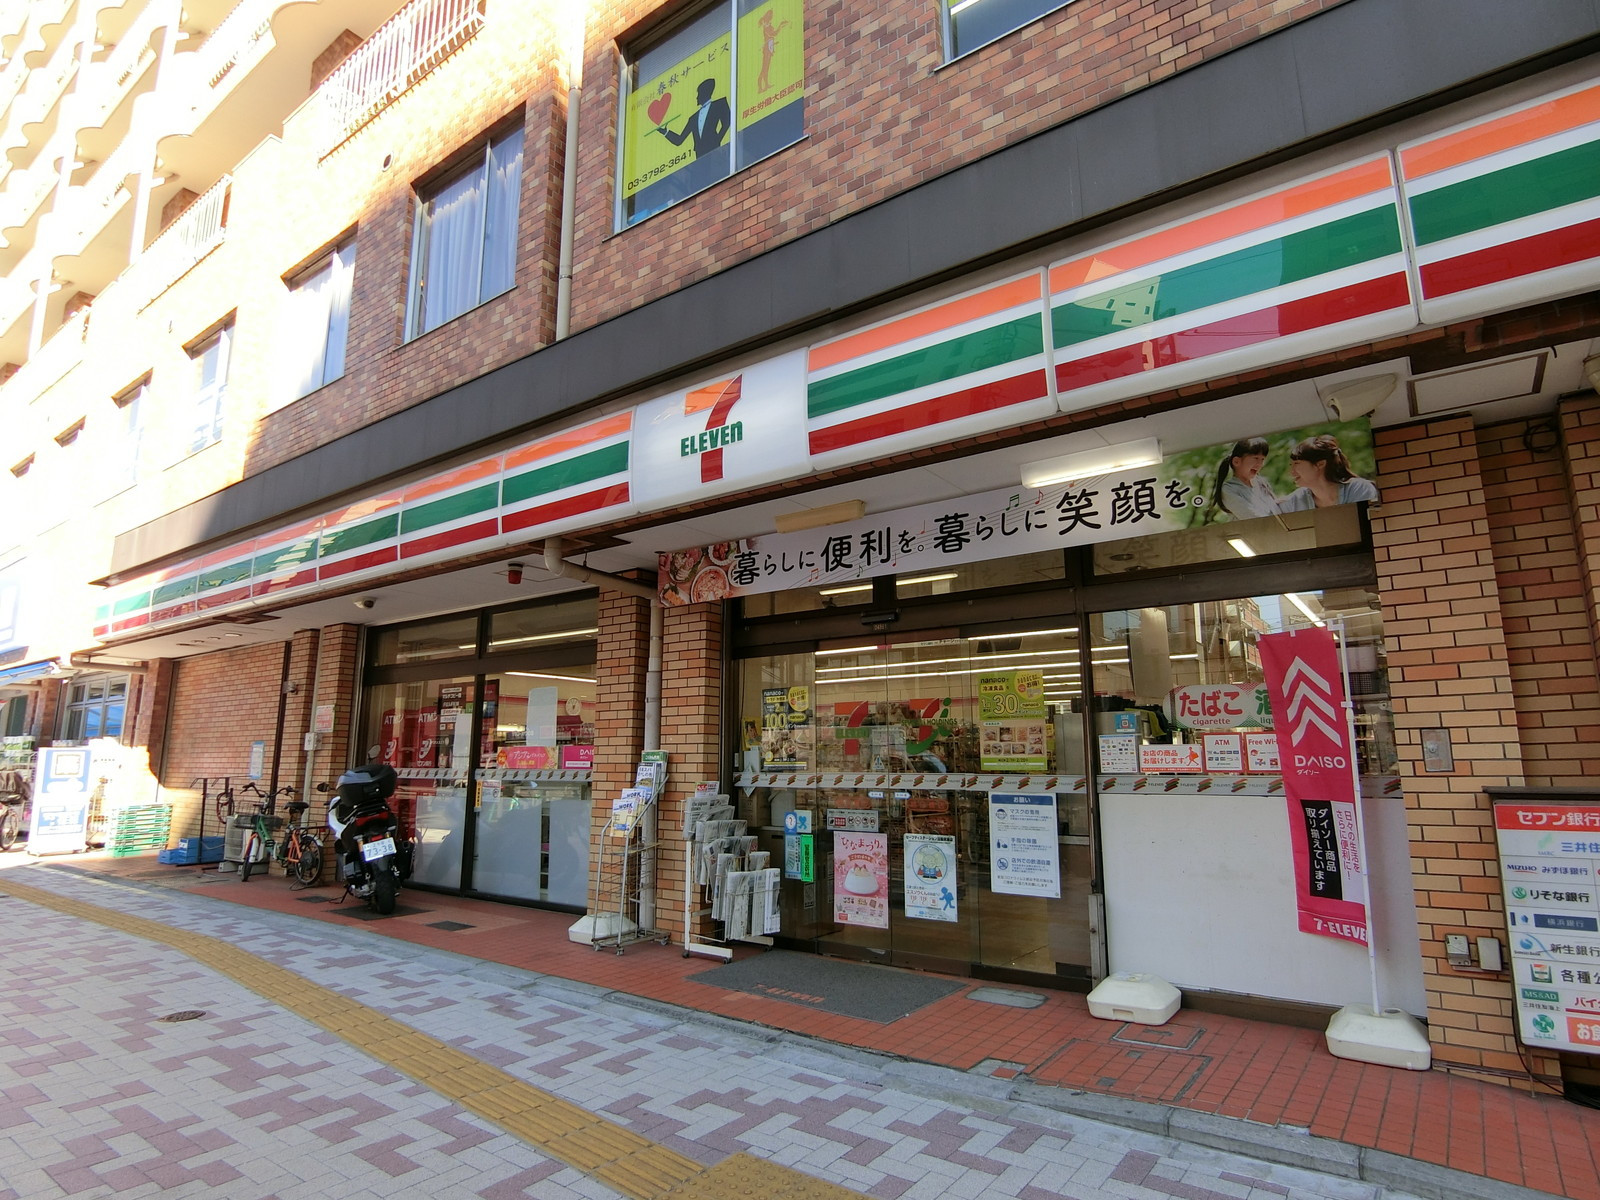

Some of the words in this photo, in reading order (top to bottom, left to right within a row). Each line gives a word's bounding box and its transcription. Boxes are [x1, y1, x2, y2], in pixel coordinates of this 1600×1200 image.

[657, 43, 729, 95] 春秋サービス
[627, 149, 693, 191] 03-3792-3641
[684, 373, 743, 484] 7
[680, 420, 743, 457] ELEVEN
[993, 693, 1018, 715] 30
[1179, 690, 1243, 717] たばこ
[1192, 718, 1231, 726] cigarette
[1248, 738, 1263, 746] Free
[1263, 737, 1279, 746] Wi-
[1142, 749, 1179, 757] お店の商品
[1294, 755, 1346, 769] DAISO
[1296, 768, 1320, 776] ダイソー
[1517, 810, 1600, 827] セブン銀行
[1317, 807, 1337, 873] ダイソー商品
[366, 844, 394, 857] 73-38
[1305, 807, 1326, 892] 取り揃えています
[1507, 864, 1537, 872] MIZUHO
[1541, 866, 1588, 876] みずほ銀行
[1530, 889, 1590, 903] りそな銀行
[1313, 917, 1368, 943] 7-ELEVE
[1550, 943, 1600, 957] 新生銀行
[1524, 990, 1557, 1000] MS&AD
[1574, 996, 1600, 1009] バイ
